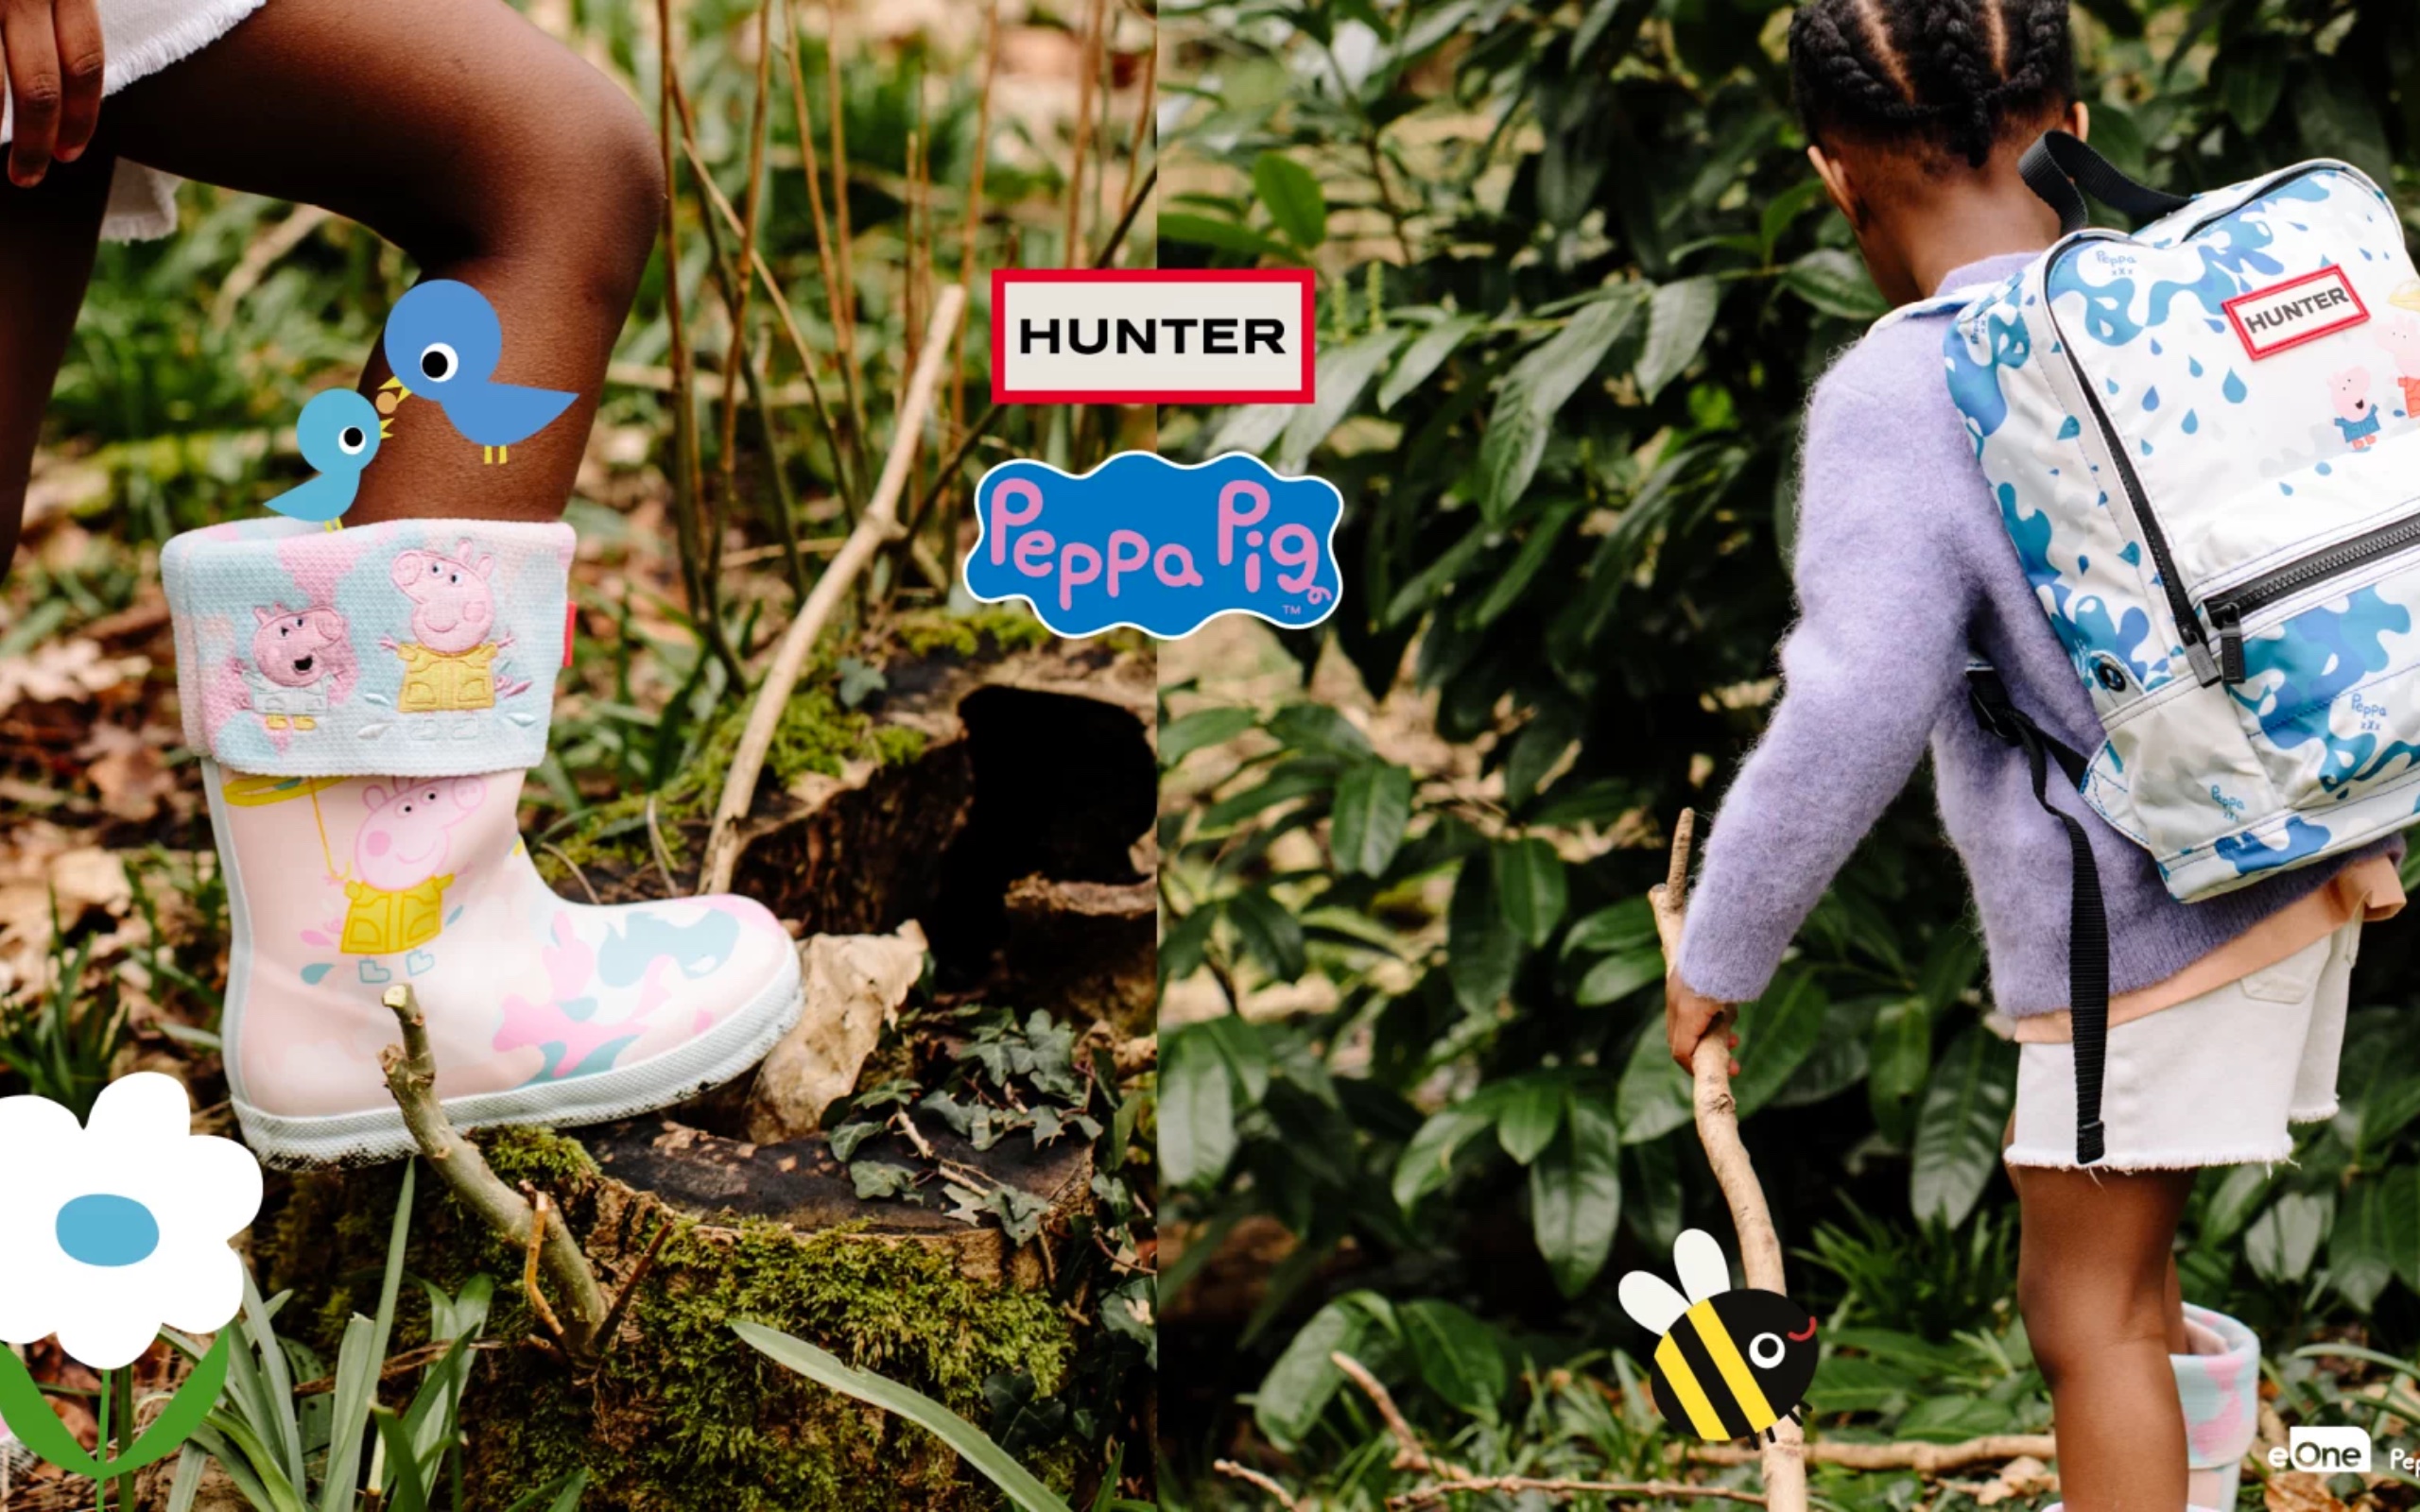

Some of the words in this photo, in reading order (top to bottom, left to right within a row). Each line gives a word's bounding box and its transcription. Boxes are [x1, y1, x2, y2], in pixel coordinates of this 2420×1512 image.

[2096, 249, 2137, 267] Peppa
[2244, 286, 2350, 334] HUNTER
[2351, 693, 2387, 718] Peppa
